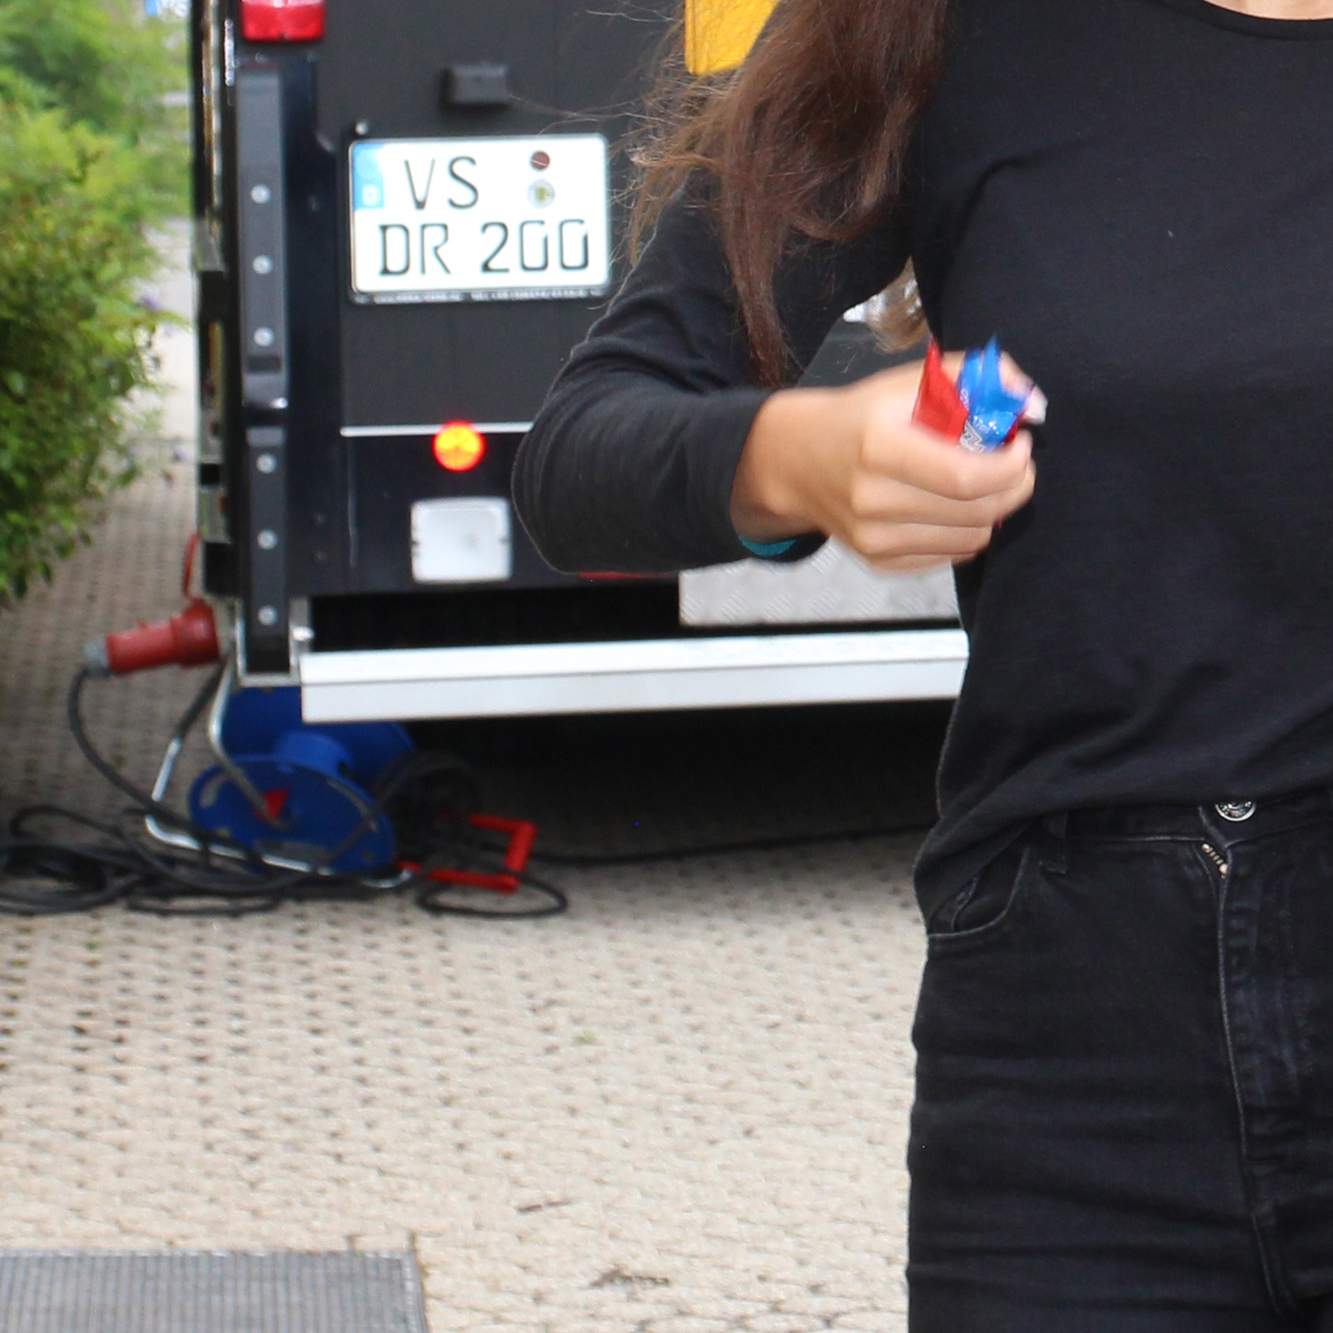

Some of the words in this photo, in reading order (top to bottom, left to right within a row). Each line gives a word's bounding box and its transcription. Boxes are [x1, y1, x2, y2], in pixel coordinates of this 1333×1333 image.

[403, 155, 480, 210] VS
[378, 222, 452, 276] DR
[480, 219, 590, 273] 200
